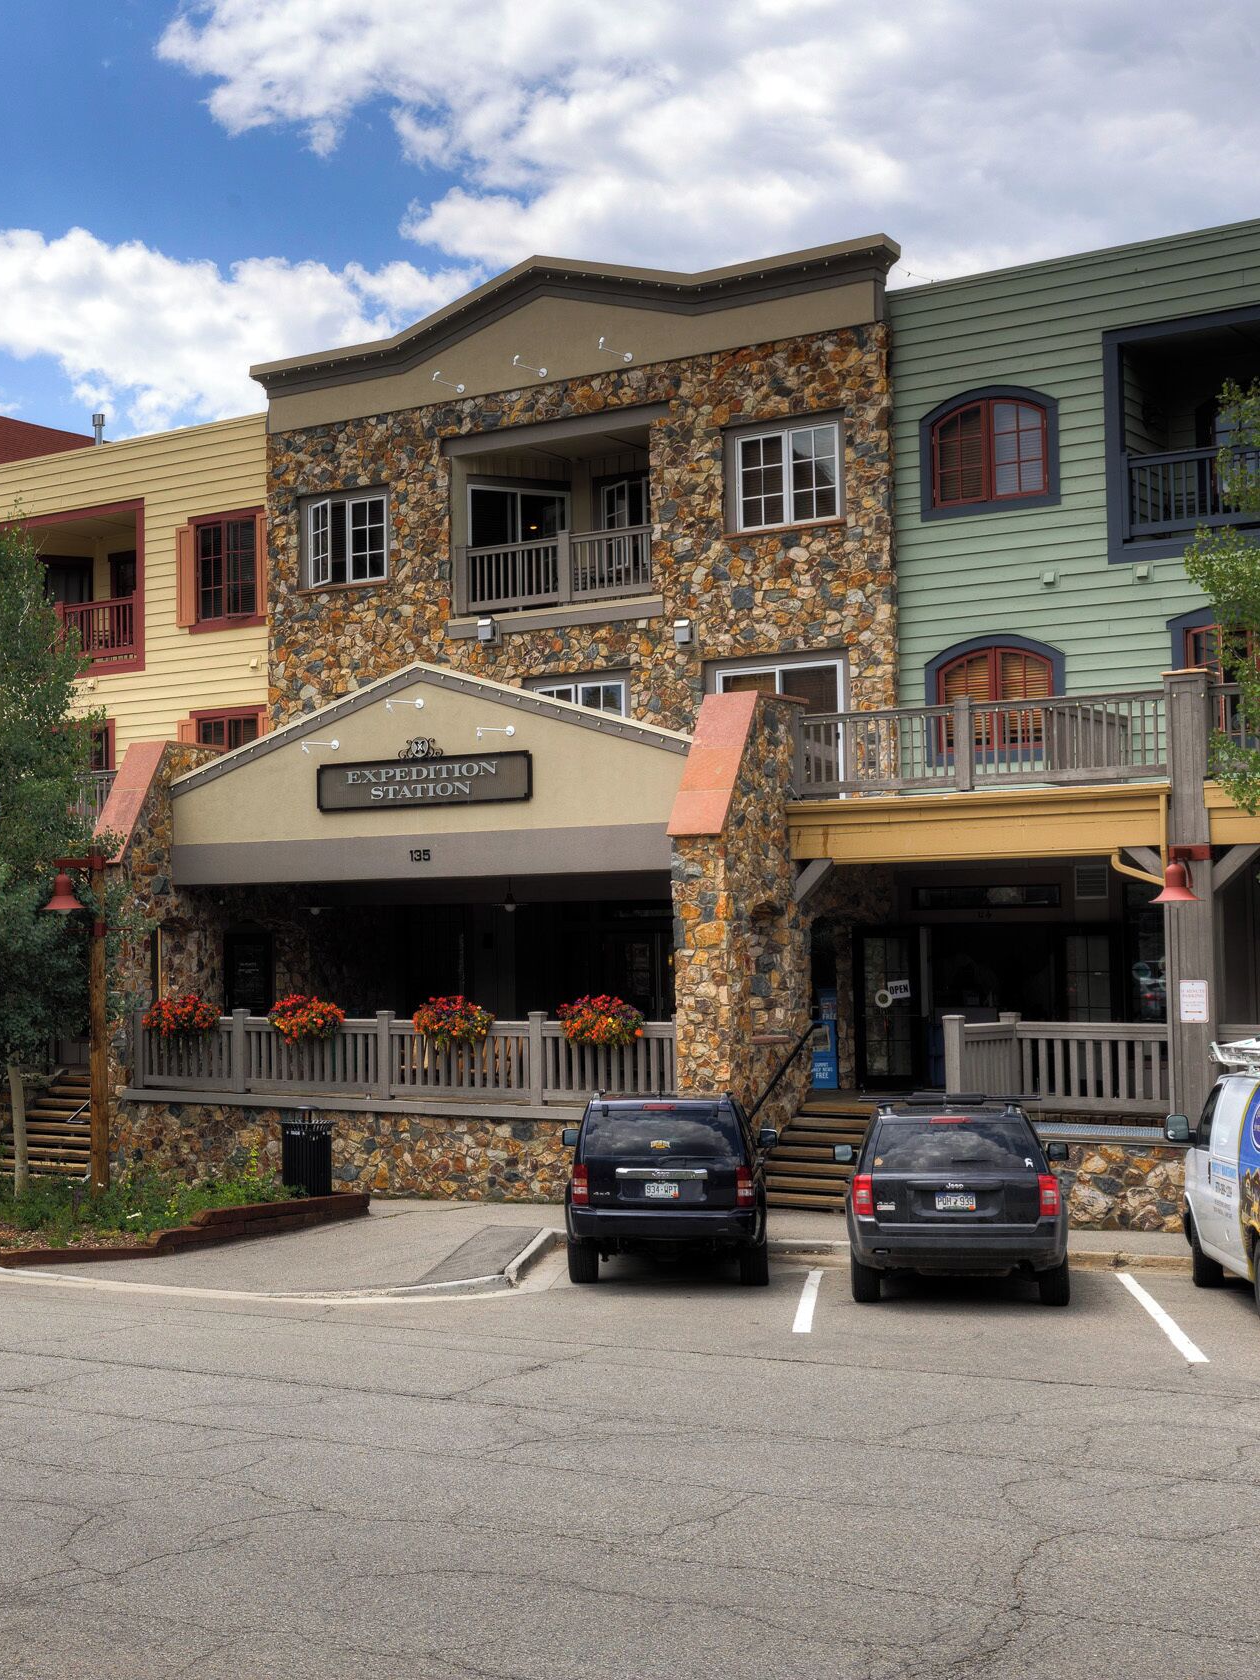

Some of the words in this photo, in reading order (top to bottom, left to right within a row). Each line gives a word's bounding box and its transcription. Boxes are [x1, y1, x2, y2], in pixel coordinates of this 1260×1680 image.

[346, 760, 498, 785] EXPEDITION
[370, 780, 472, 801] STATION
[409, 849, 431, 862] 135
[889, 983, 909, 995] OPEN
[946, 1182, 964, 1191] Jeep
